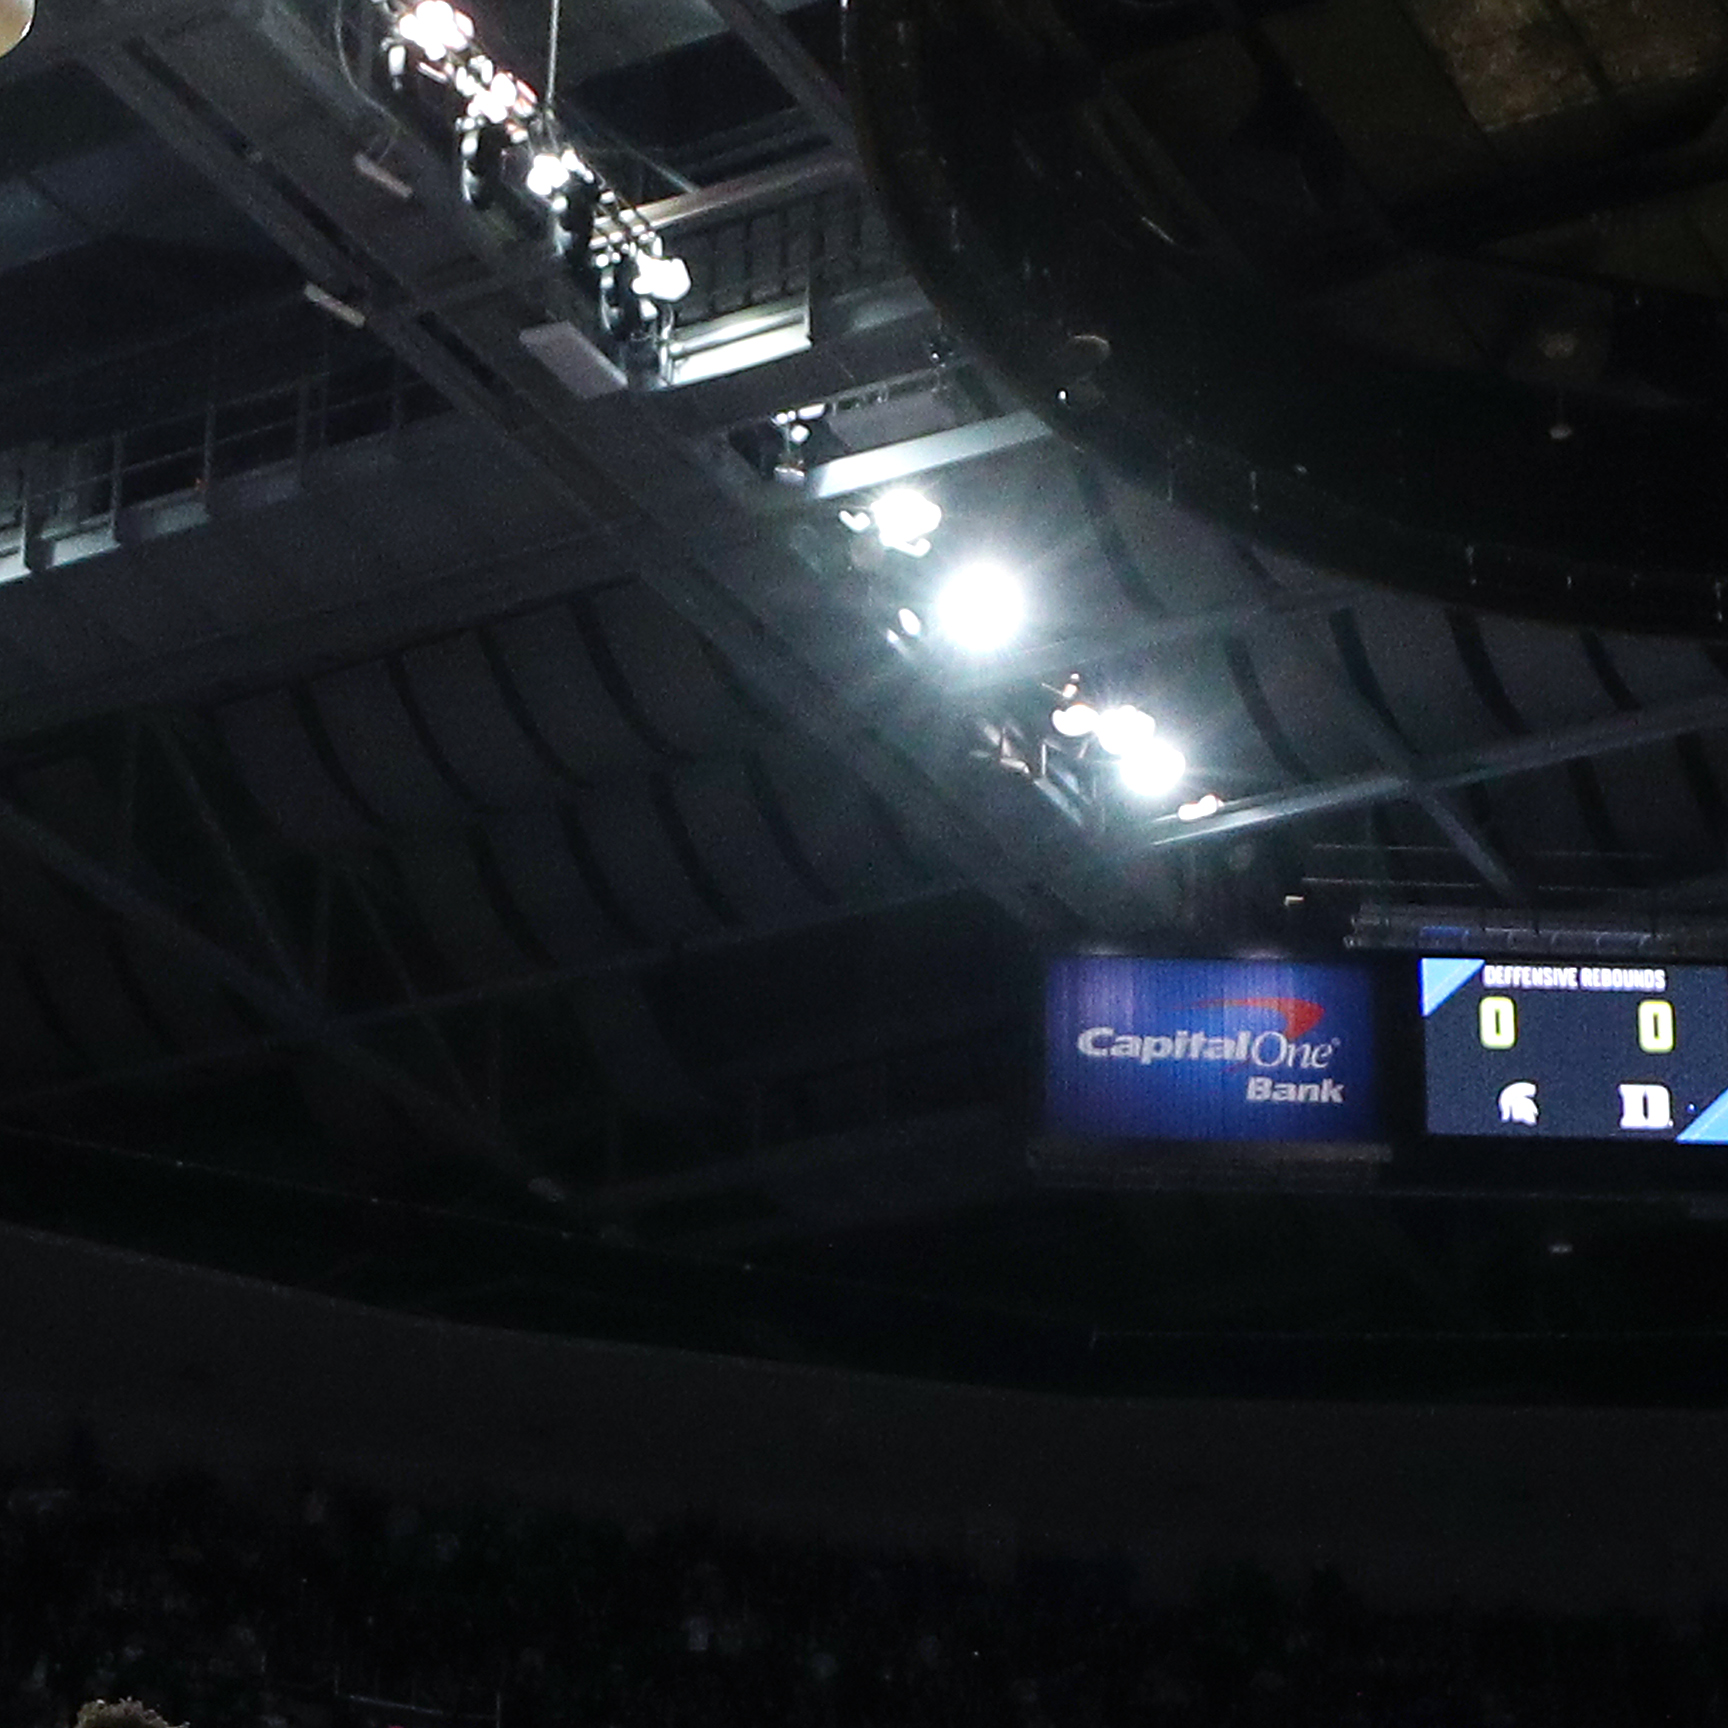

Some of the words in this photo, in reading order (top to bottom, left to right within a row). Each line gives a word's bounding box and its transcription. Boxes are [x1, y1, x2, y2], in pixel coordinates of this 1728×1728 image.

[1580, 968, 1666, 992] REBOUNDS
[1479, 996, 1516, 1049] 0
[1638, 1000, 1675, 1053] 0
[1245, 1076, 1344, 1104] Bank
